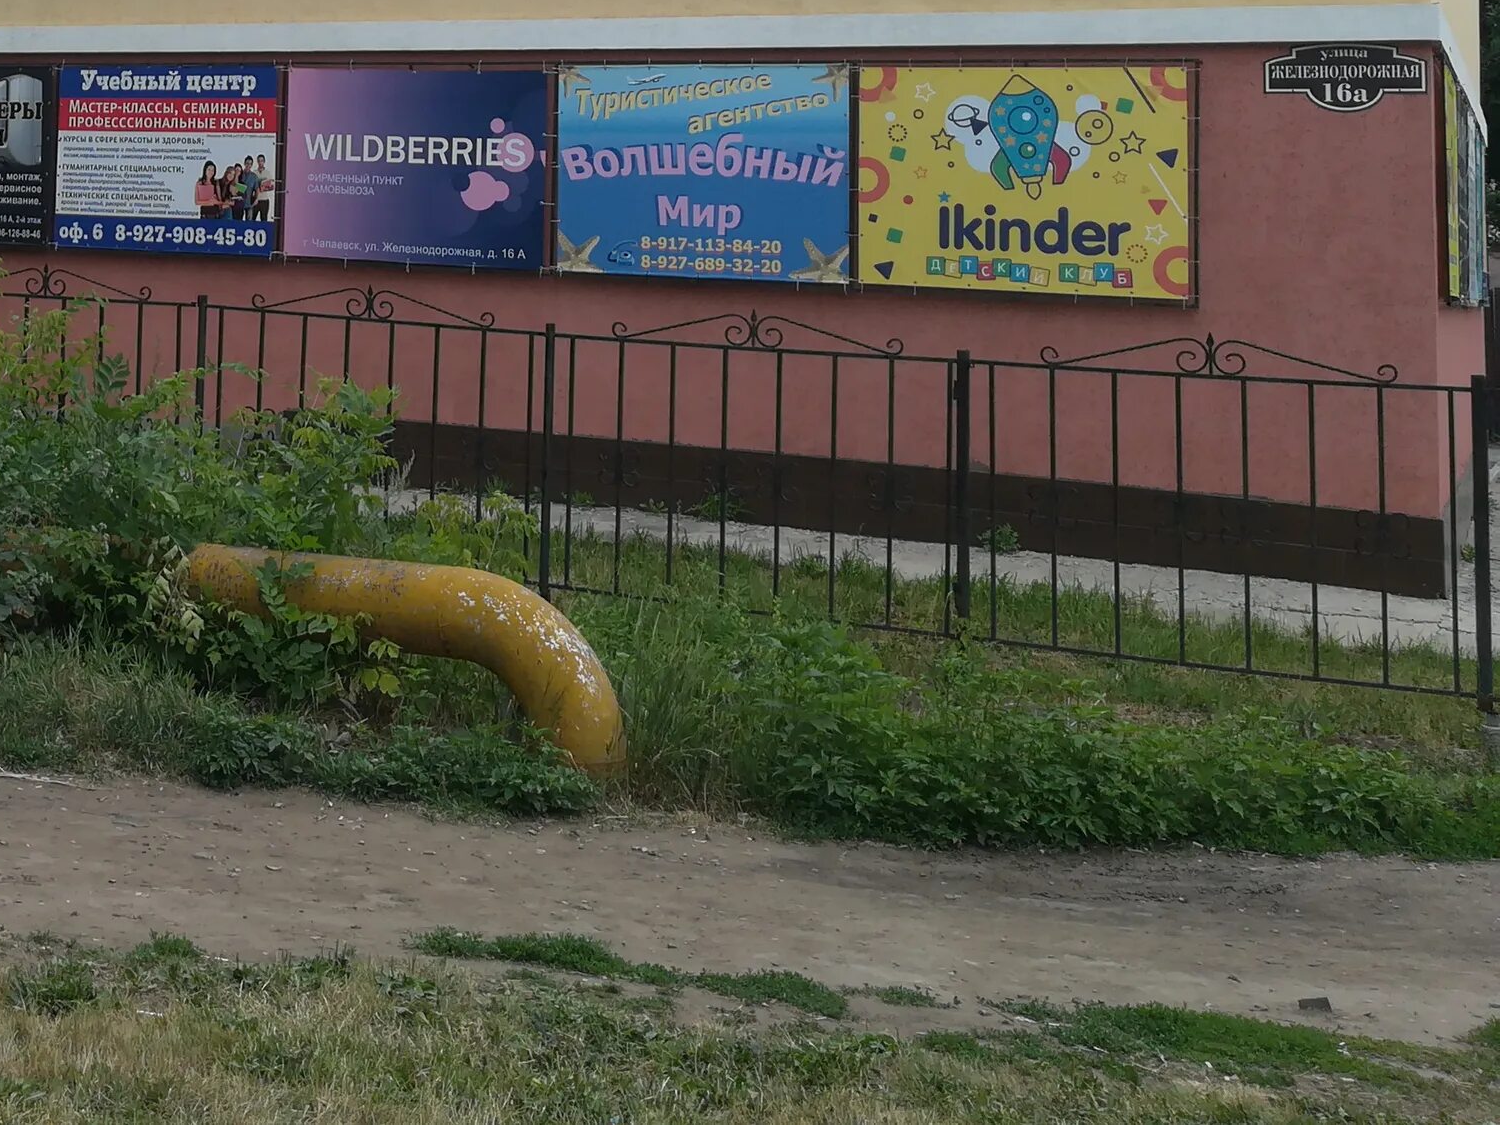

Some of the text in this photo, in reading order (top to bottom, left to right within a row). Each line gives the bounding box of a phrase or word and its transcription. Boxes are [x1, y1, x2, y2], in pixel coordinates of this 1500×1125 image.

[1320, 48, 1368, 61] улица
[80, 69, 257, 96] Учебный центр
[1271, 65, 1420, 81] ЖЕЛЕЗНОДОРОЖНАЯ
[575, 73, 772, 121] Туристическое
[182, 102, 263, 117] СЕМИНАРЫ,
[688, 92, 829, 134] агентство
[220, 118, 265, 130] КУРСЫ
[94, 136, 118, 144] СФЕРЕ
[119, 136, 153, 145] КРАСОТЫ
[161, 137, 205, 146] ЗДОРОВЬЯ;
[304, 133, 526, 167] WILDBERRIES
[62, 164, 184, 174] ГУМАНИТАРНЫЕ СПЕЦИАЛЬНОСТИ;
[561, 132, 846, 187] Волшебный
[6, 173, 43, 183] монтаж,
[308, 173, 404, 186] ФИРМЕННЫЙ ПУНКТ
[62, 192, 175, 201] ТЕХНИЧЕСКИЕ СПЕЦИАЛЬНОСТИ.
[308, 184, 375, 196] САМОВЫВОЗА
[656, 194, 742, 235] Мир
[59, 222, 267, 246] оф. 6 8-927-908-45-80
[311, 238, 362, 252] Чапаевск,
[365, 241, 380, 253] ул.
[382, 241, 485, 259] Железнодорожная,
[487, 249, 498, 260] д.
[501, 248, 515, 259] 16
[640, 236, 782, 255] 8-917-113-84-20
[640, 255, 782, 274] 8-927-689-32-20
[929, 257, 1130, 286] ДЕТСКИЙ КЛУБ
